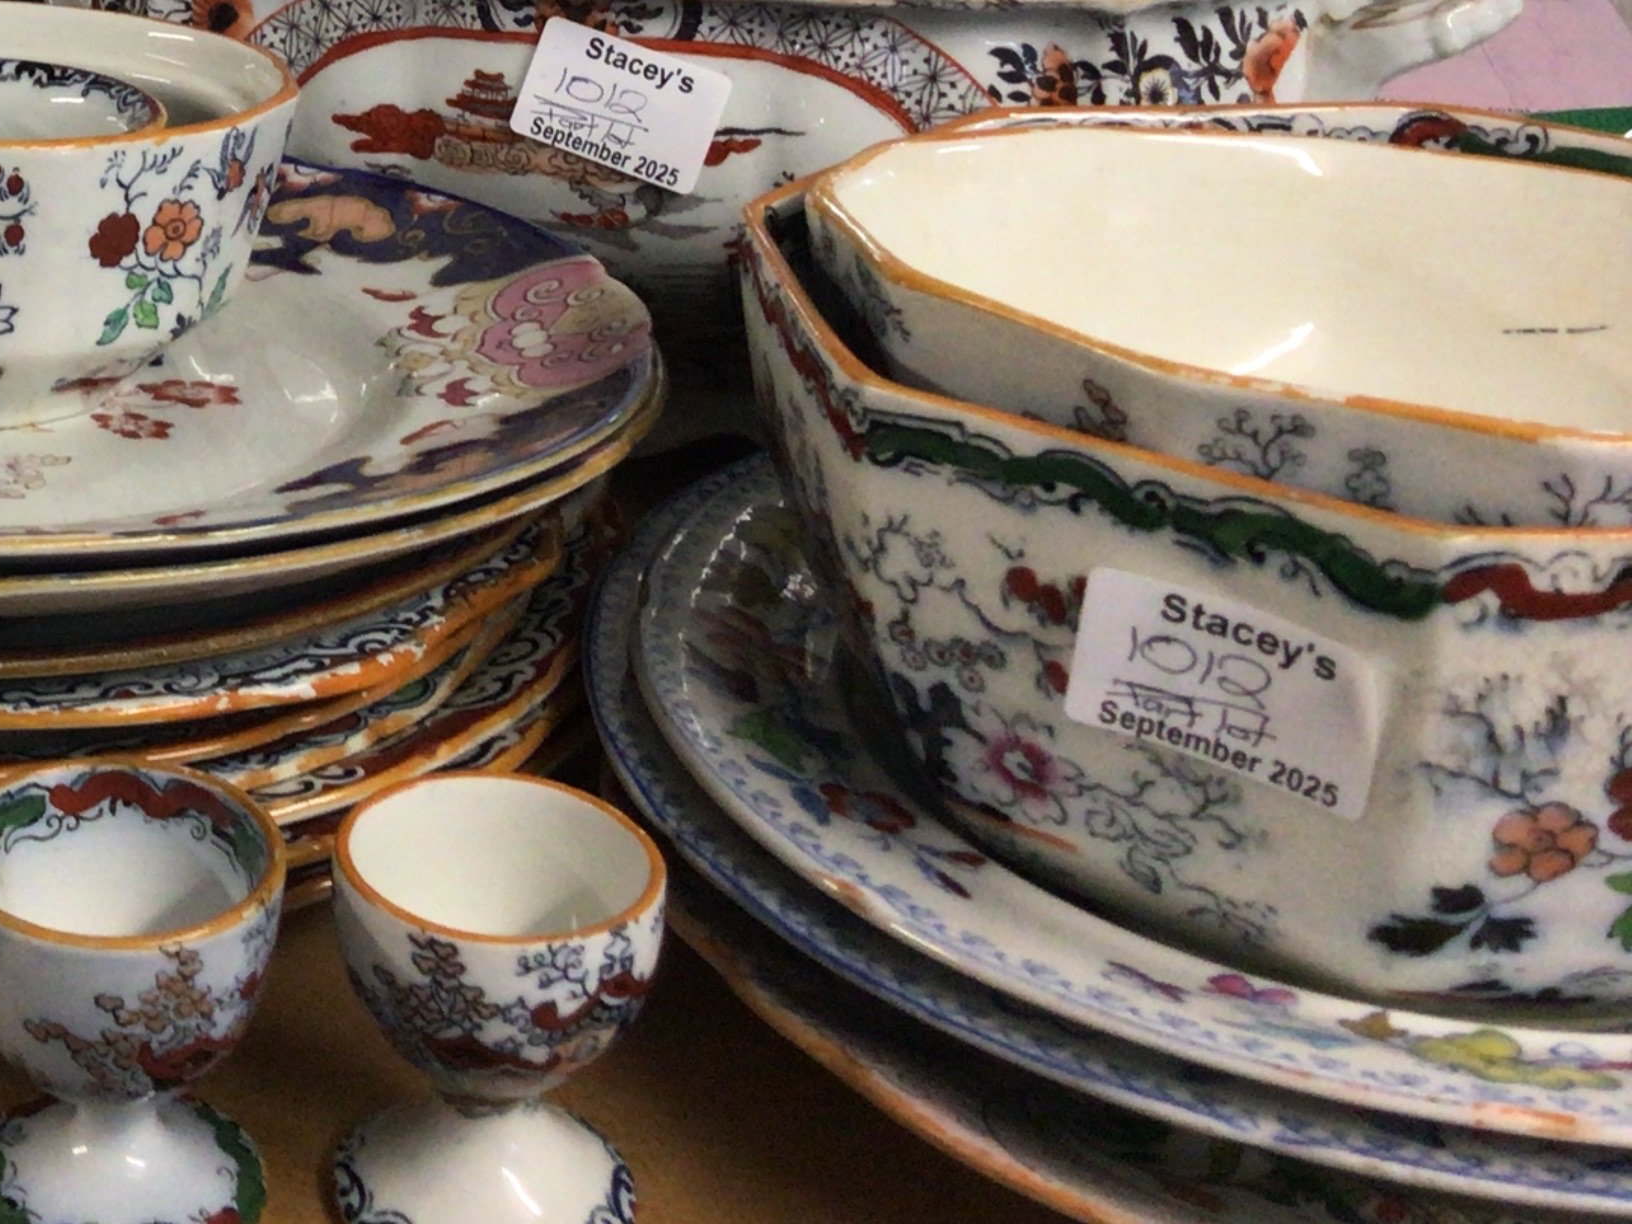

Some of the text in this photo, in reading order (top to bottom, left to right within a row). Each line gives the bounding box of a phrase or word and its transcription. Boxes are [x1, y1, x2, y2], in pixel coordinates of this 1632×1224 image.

[554, 67, 648, 123] 1012
[585, 36, 695, 94] Stacey's
[530, 116, 680, 187] September 2025
[1128, 625, 1273, 711] 1012
[1161, 592, 1338, 681] Stacey's
[1098, 699, 1340, 809] September 2025
